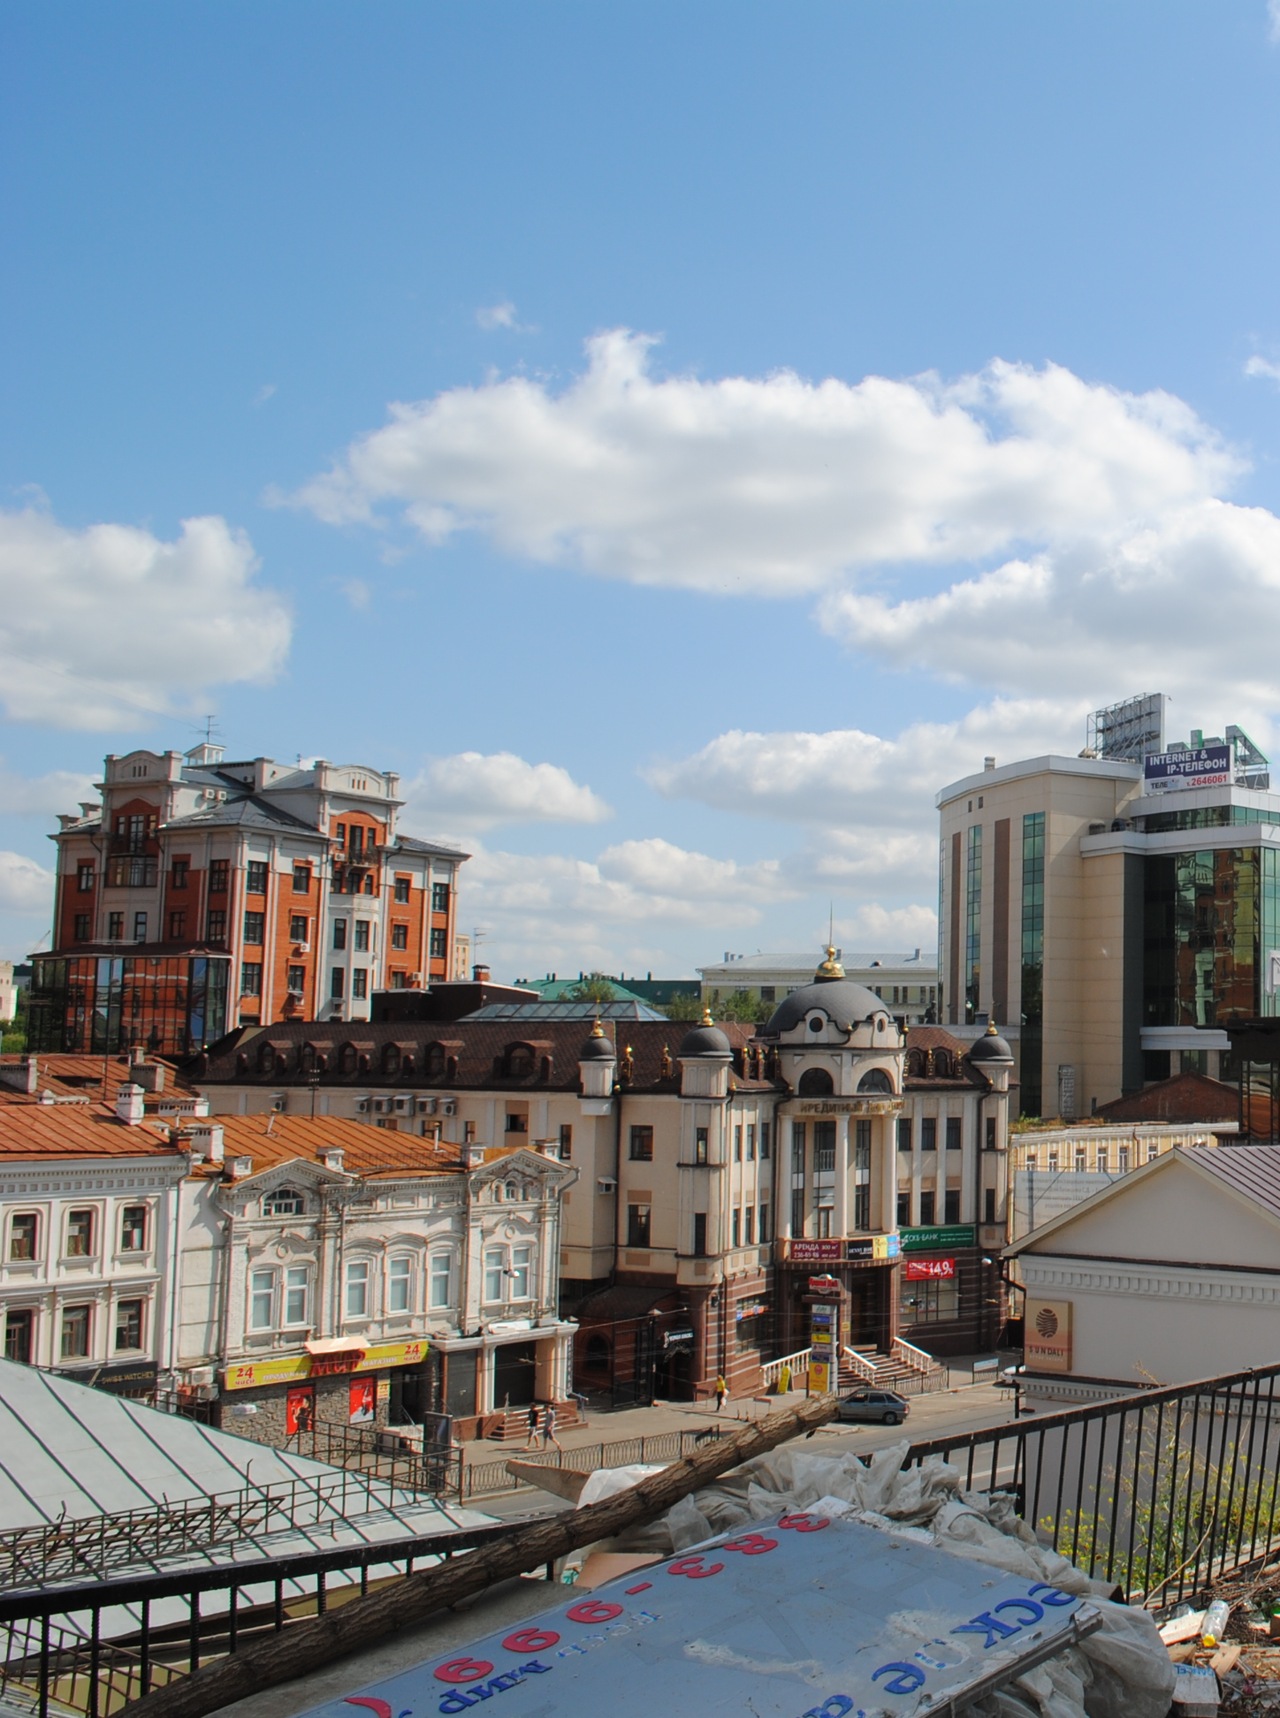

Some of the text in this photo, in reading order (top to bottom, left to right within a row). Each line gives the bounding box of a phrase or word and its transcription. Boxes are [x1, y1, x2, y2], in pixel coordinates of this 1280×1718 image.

[1150, 749, 1208, 766] INTERNET &
[1167, 758, 1226, 775] IP-ТЕЛЕФОН
[794, 1243, 819, 1251] АРЕНДА
[402, 1343, 420, 1355] 24
[236, 1366, 254, 1379] 24
